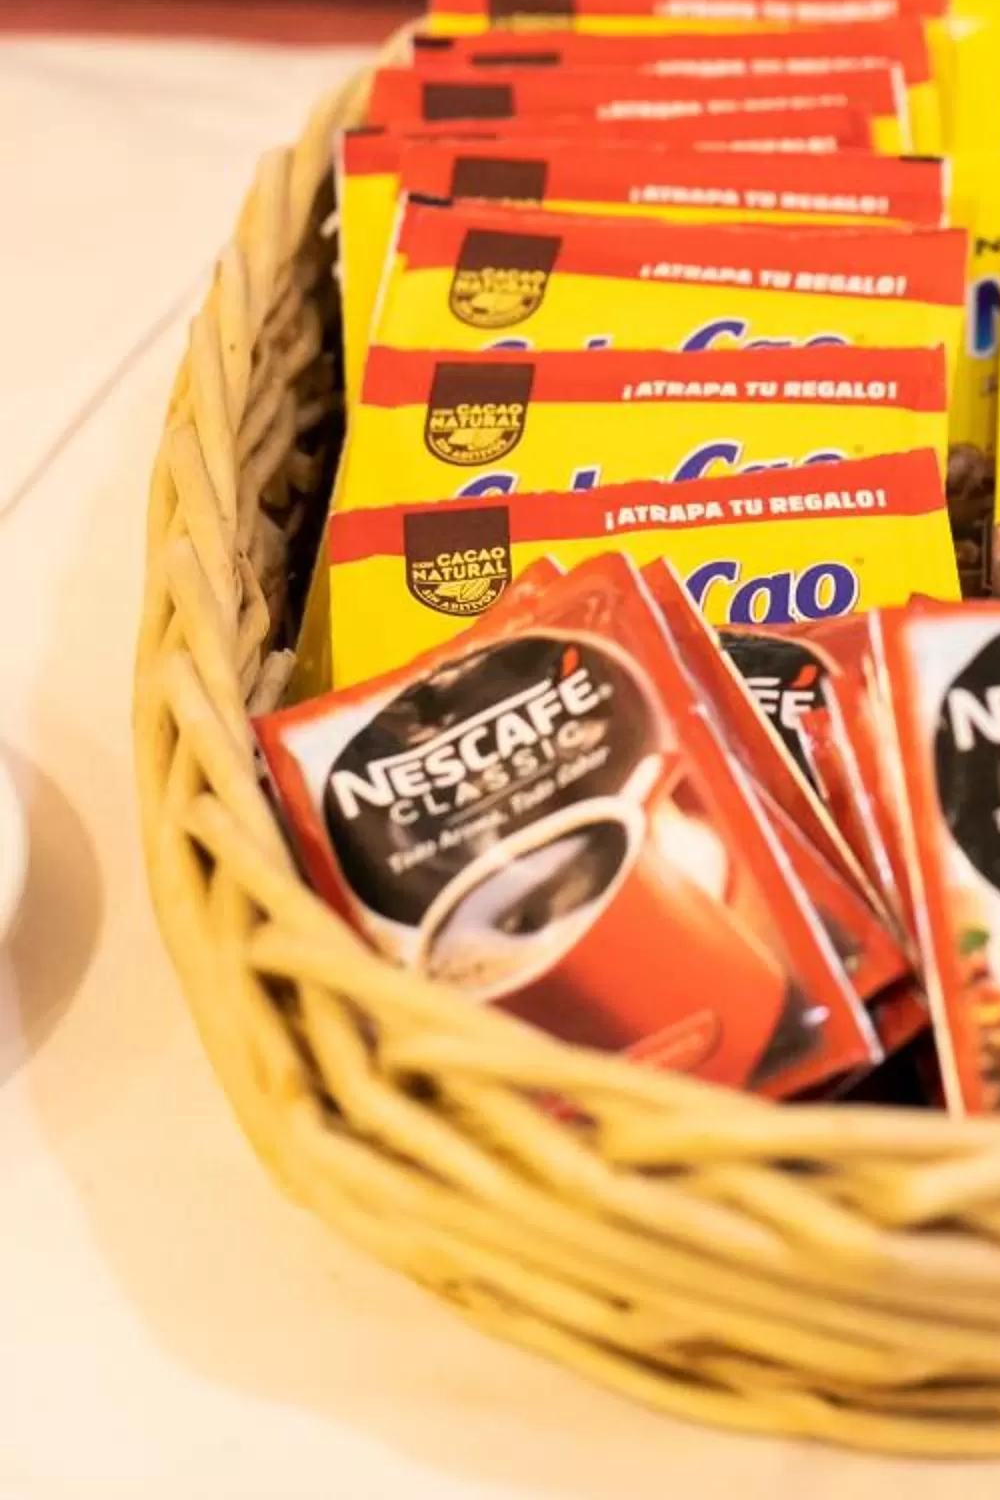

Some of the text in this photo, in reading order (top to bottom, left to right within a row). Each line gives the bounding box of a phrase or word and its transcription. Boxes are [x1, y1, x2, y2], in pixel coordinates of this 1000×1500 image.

[759, 269, 792, 288] TU
[745, 381, 778, 397] TU
[783, 381, 898, 399] REGALO!
[728, 498, 764, 517] TU
[769, 488, 888, 514] REGALO!
[436, 547, 506, 567] CACAO
[411, 559, 508, 581] NATURAL
[330, 644, 601, 821] NESCAFÉ
[389, 719, 585, 827] CLASSIC
